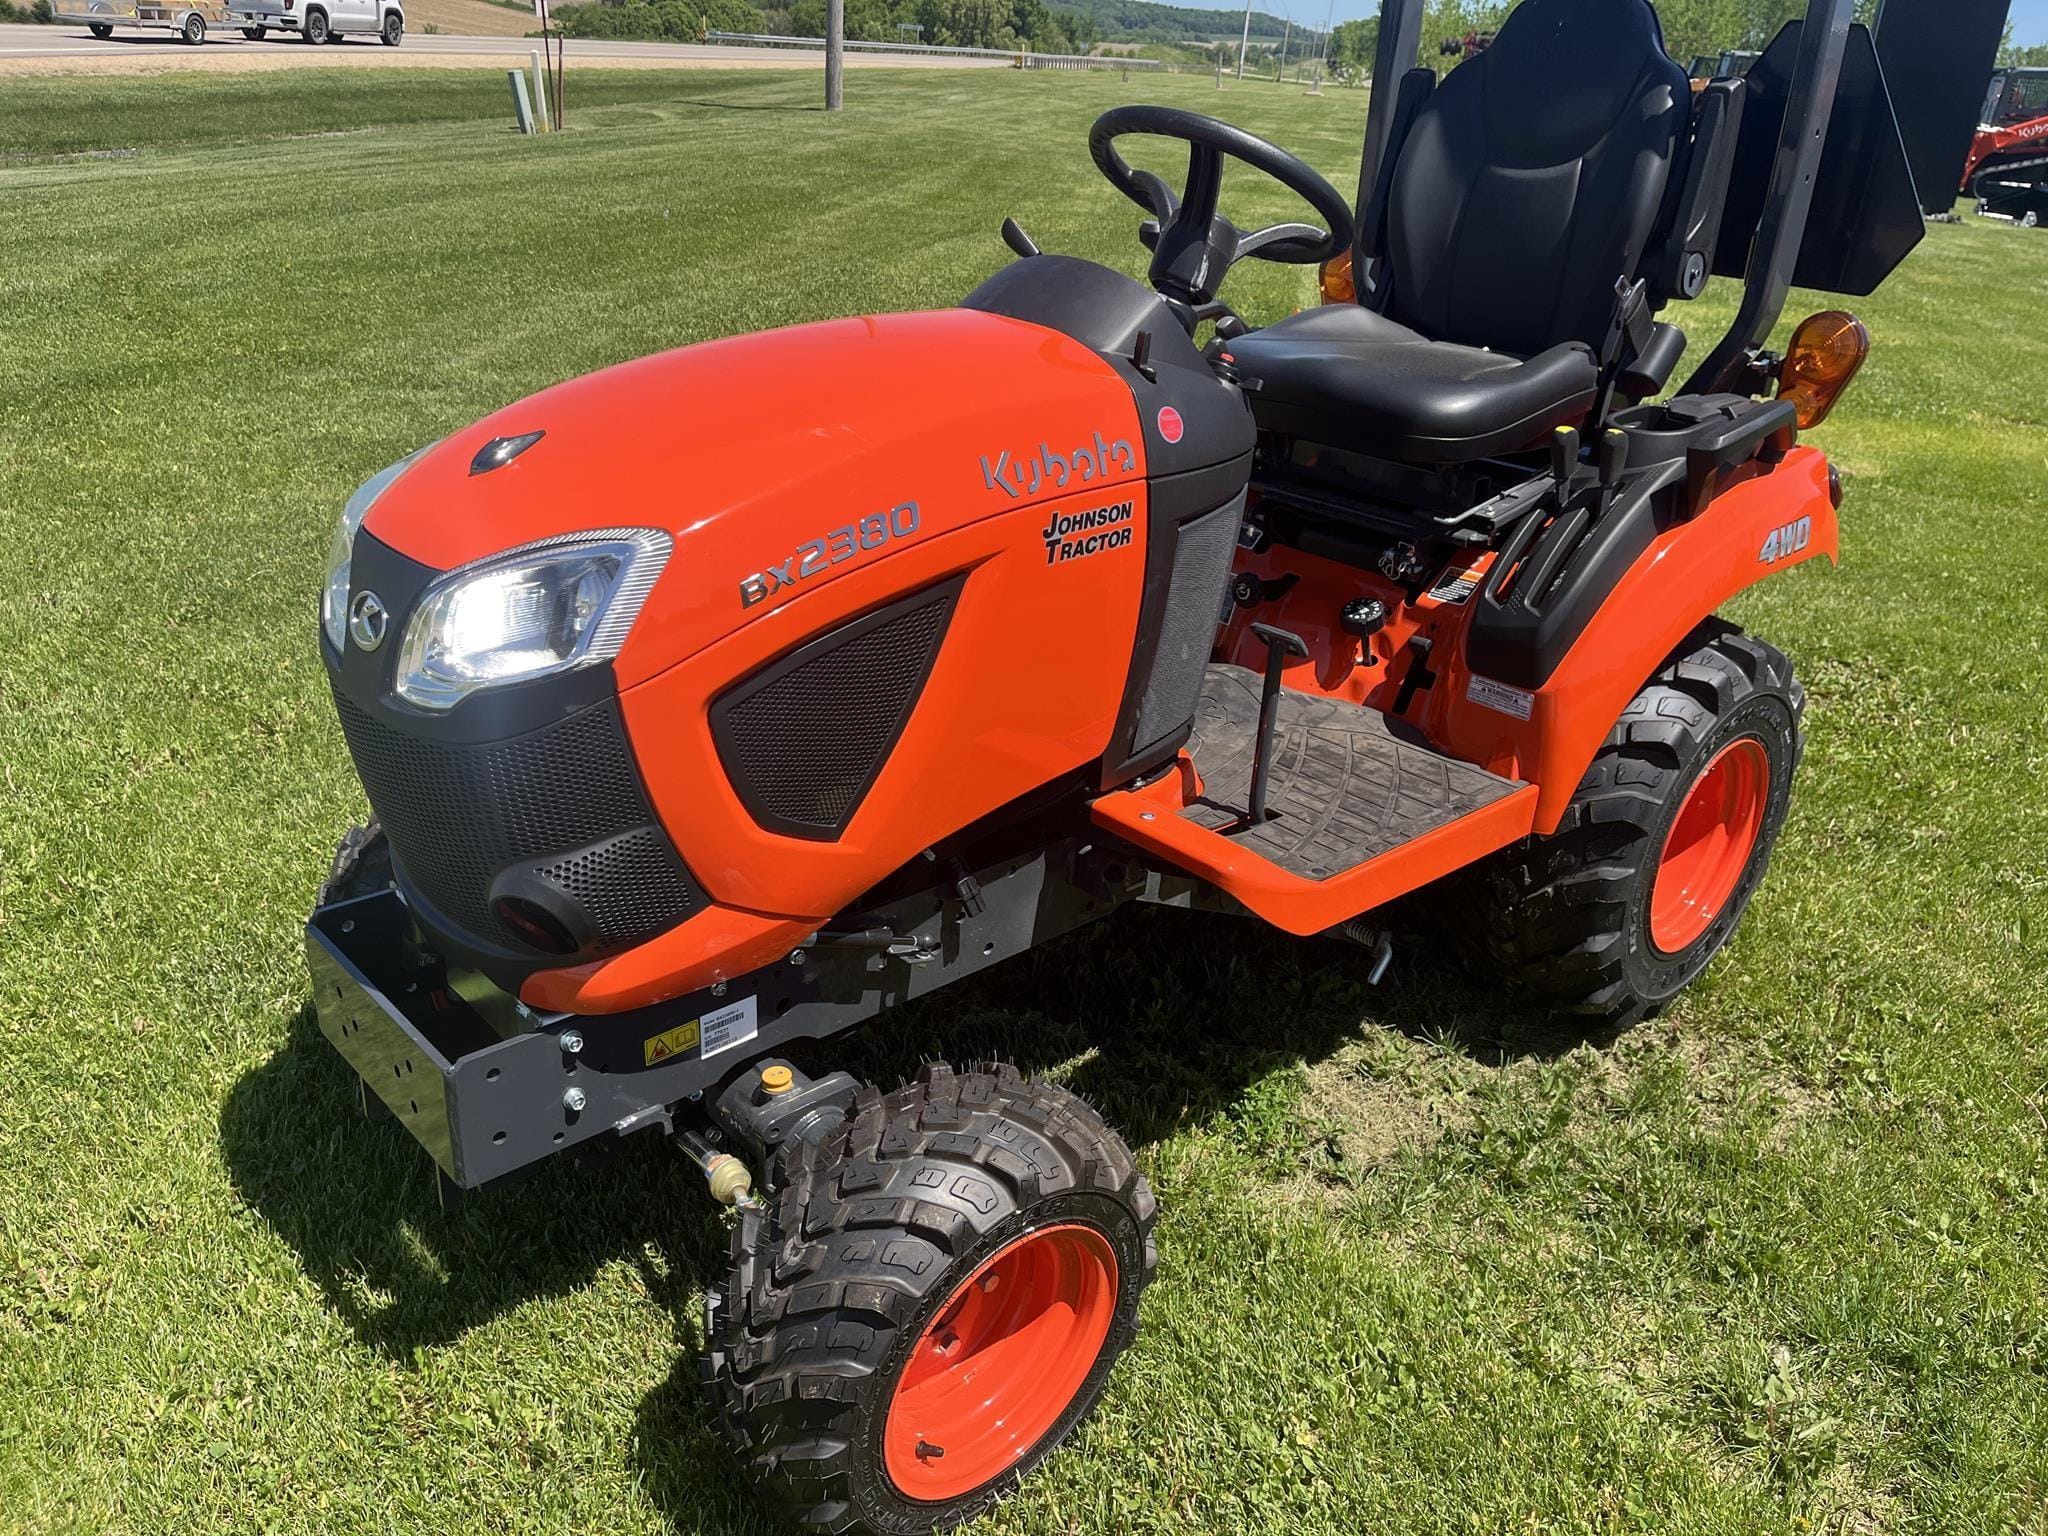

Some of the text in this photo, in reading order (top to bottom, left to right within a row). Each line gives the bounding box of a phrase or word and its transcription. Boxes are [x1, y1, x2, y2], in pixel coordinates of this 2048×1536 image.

[980, 432, 1136, 498] Kubota
[1043, 501, 1133, 540] JOHNSON
[1044, 527, 1132, 566] TRACTOR
[1758, 514, 1812, 566] 4WD
[740, 501, 920, 609] BX2380
